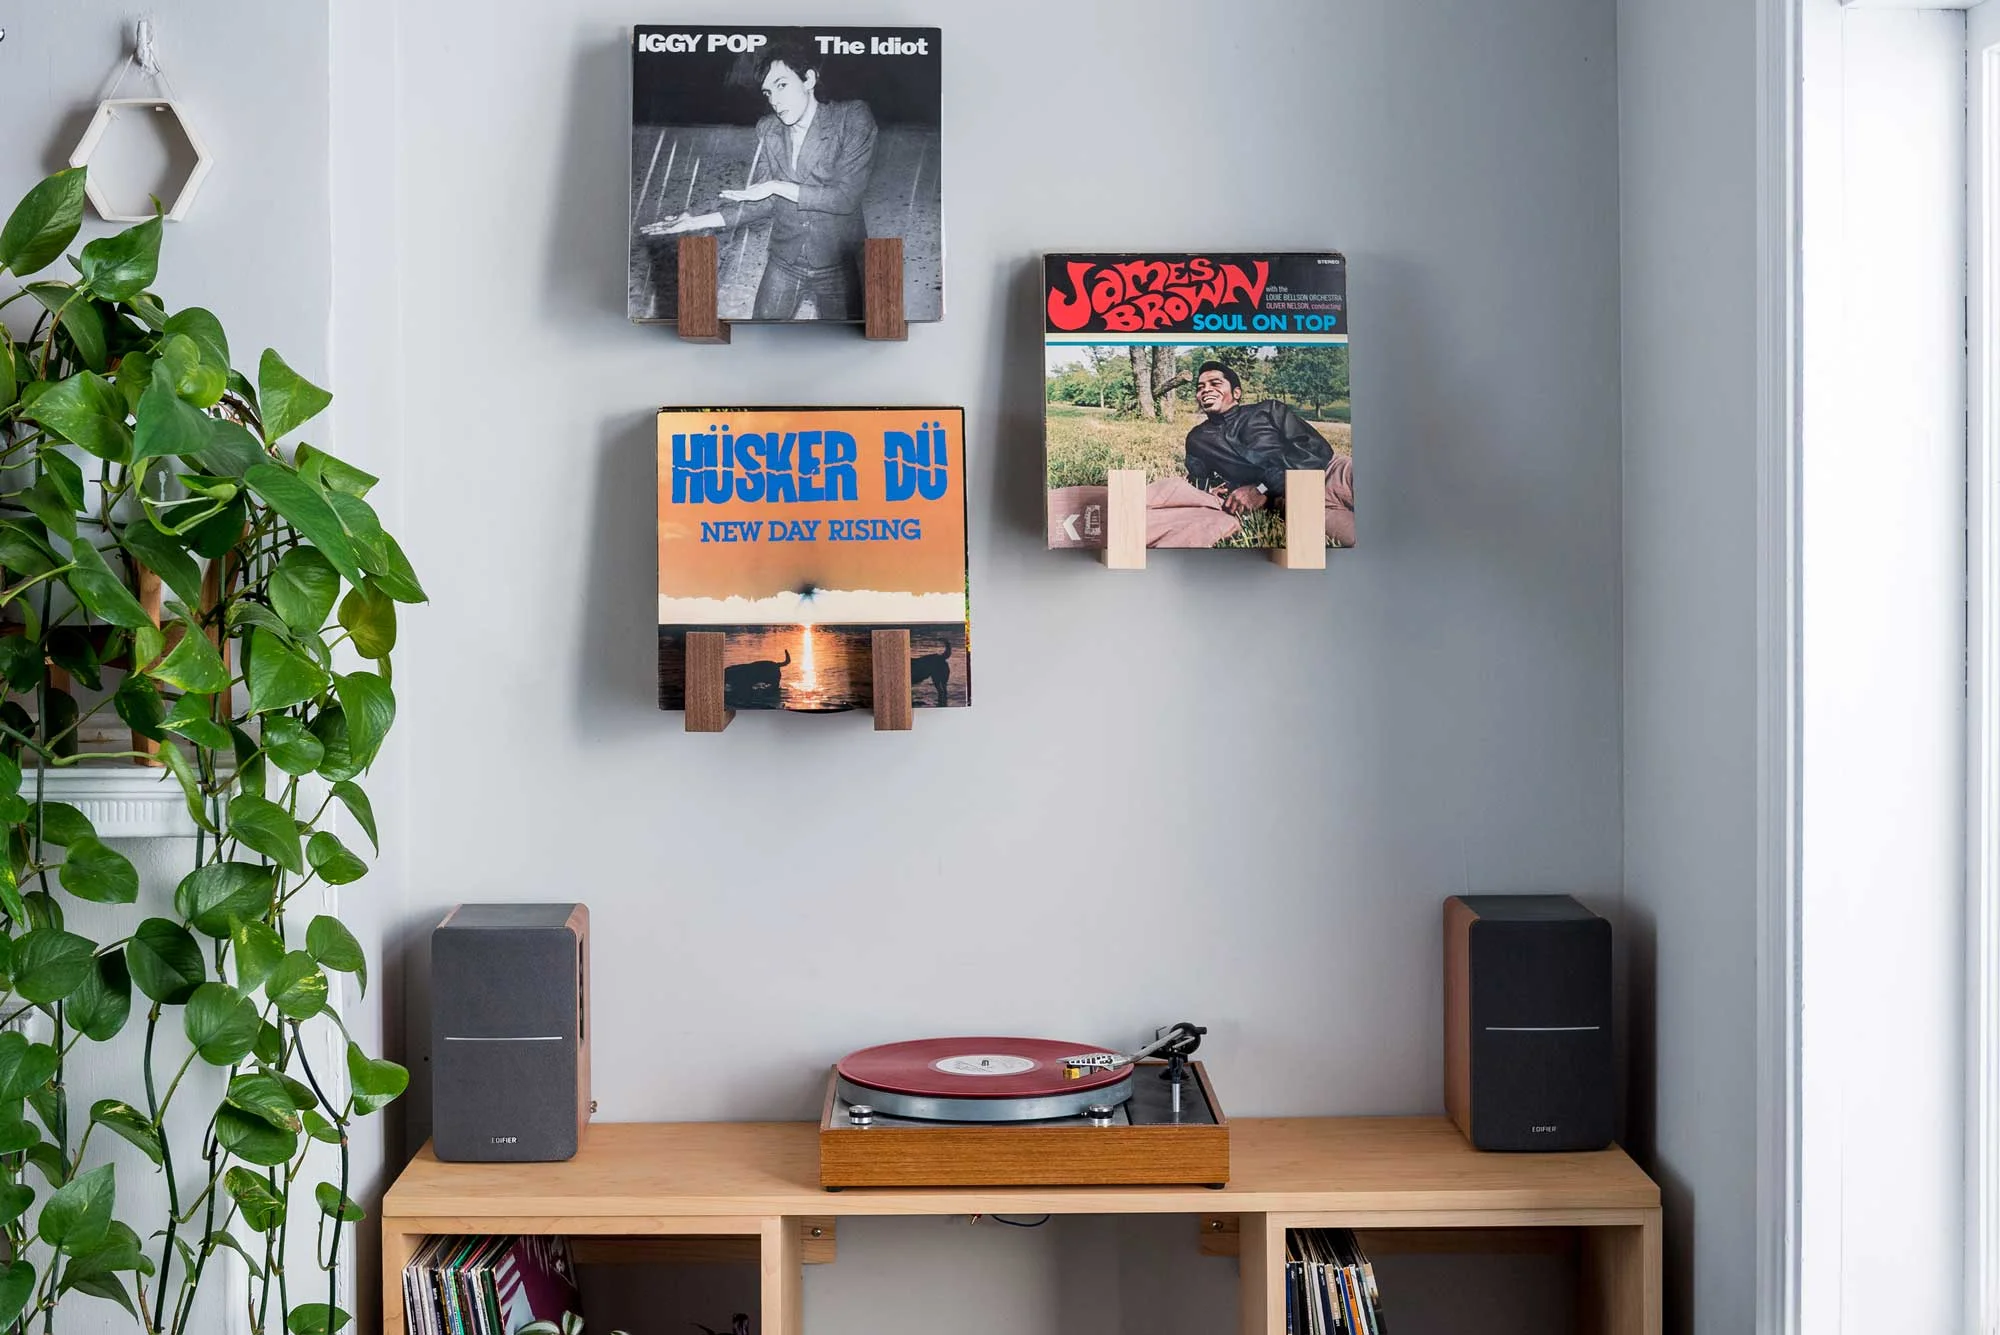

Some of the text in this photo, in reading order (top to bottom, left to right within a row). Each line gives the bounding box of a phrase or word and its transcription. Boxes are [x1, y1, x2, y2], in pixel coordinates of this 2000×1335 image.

[638, 34, 768, 53] IGGY POP
[815, 36, 929, 56] The Idiot
[1101, 260, 1269, 332] BROWN
[1265, 293, 1343, 302] LOUIE BELLSON ORCHESTRA
[1266, 302, 1286, 310] OLIVER
[1311, 303, 1342, 311] conducting
[1192, 313, 1337, 331] SOUL ON TOP
[671, 421, 948, 504] HÜSKER DÜ
[700, 518, 921, 543] NEW DAY RISING
